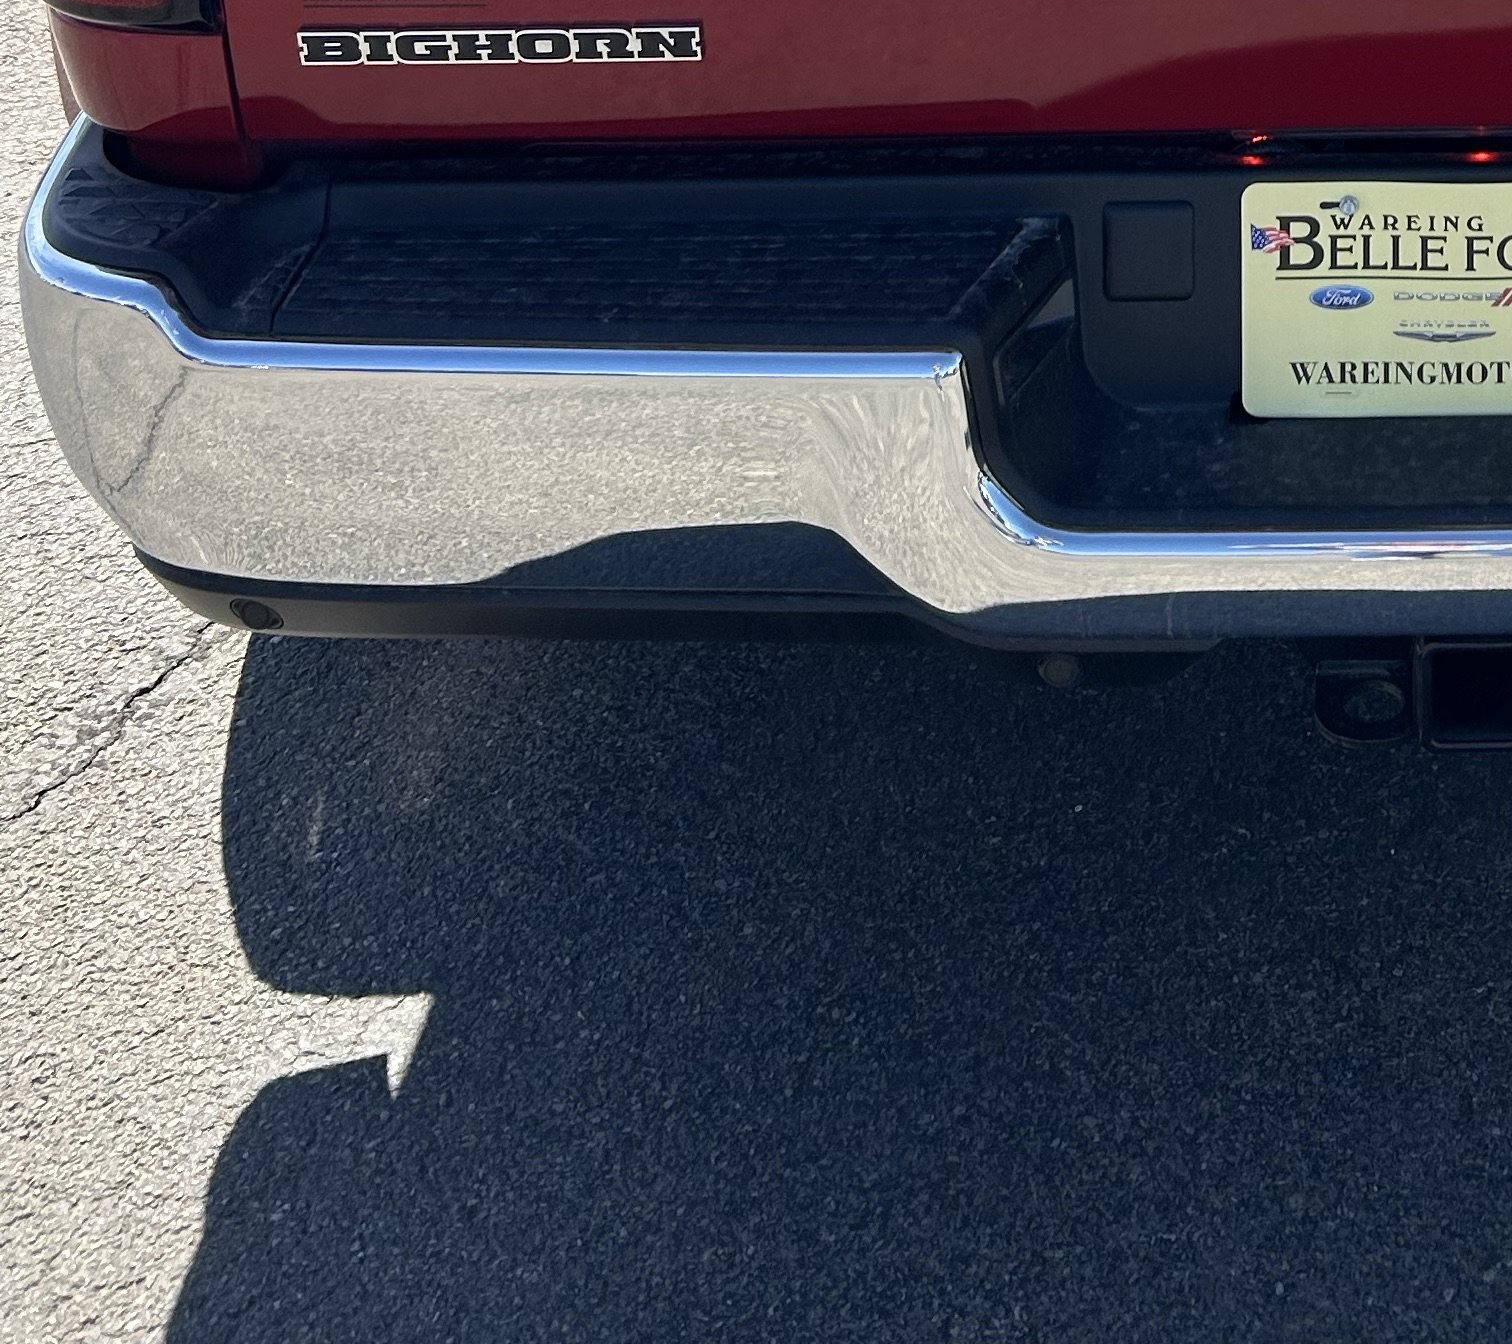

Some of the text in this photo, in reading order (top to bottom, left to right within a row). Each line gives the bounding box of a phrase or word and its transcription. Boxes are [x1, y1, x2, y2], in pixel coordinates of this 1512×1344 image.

[297, 26, 702, 65] BIGHORN
[1331, 213, 1485, 233] WAREING
[1275, 215, 1449, 272] BELLE
[1318, 289, 1364, 309] Ford
[1393, 291, 1504, 301] DODGE
